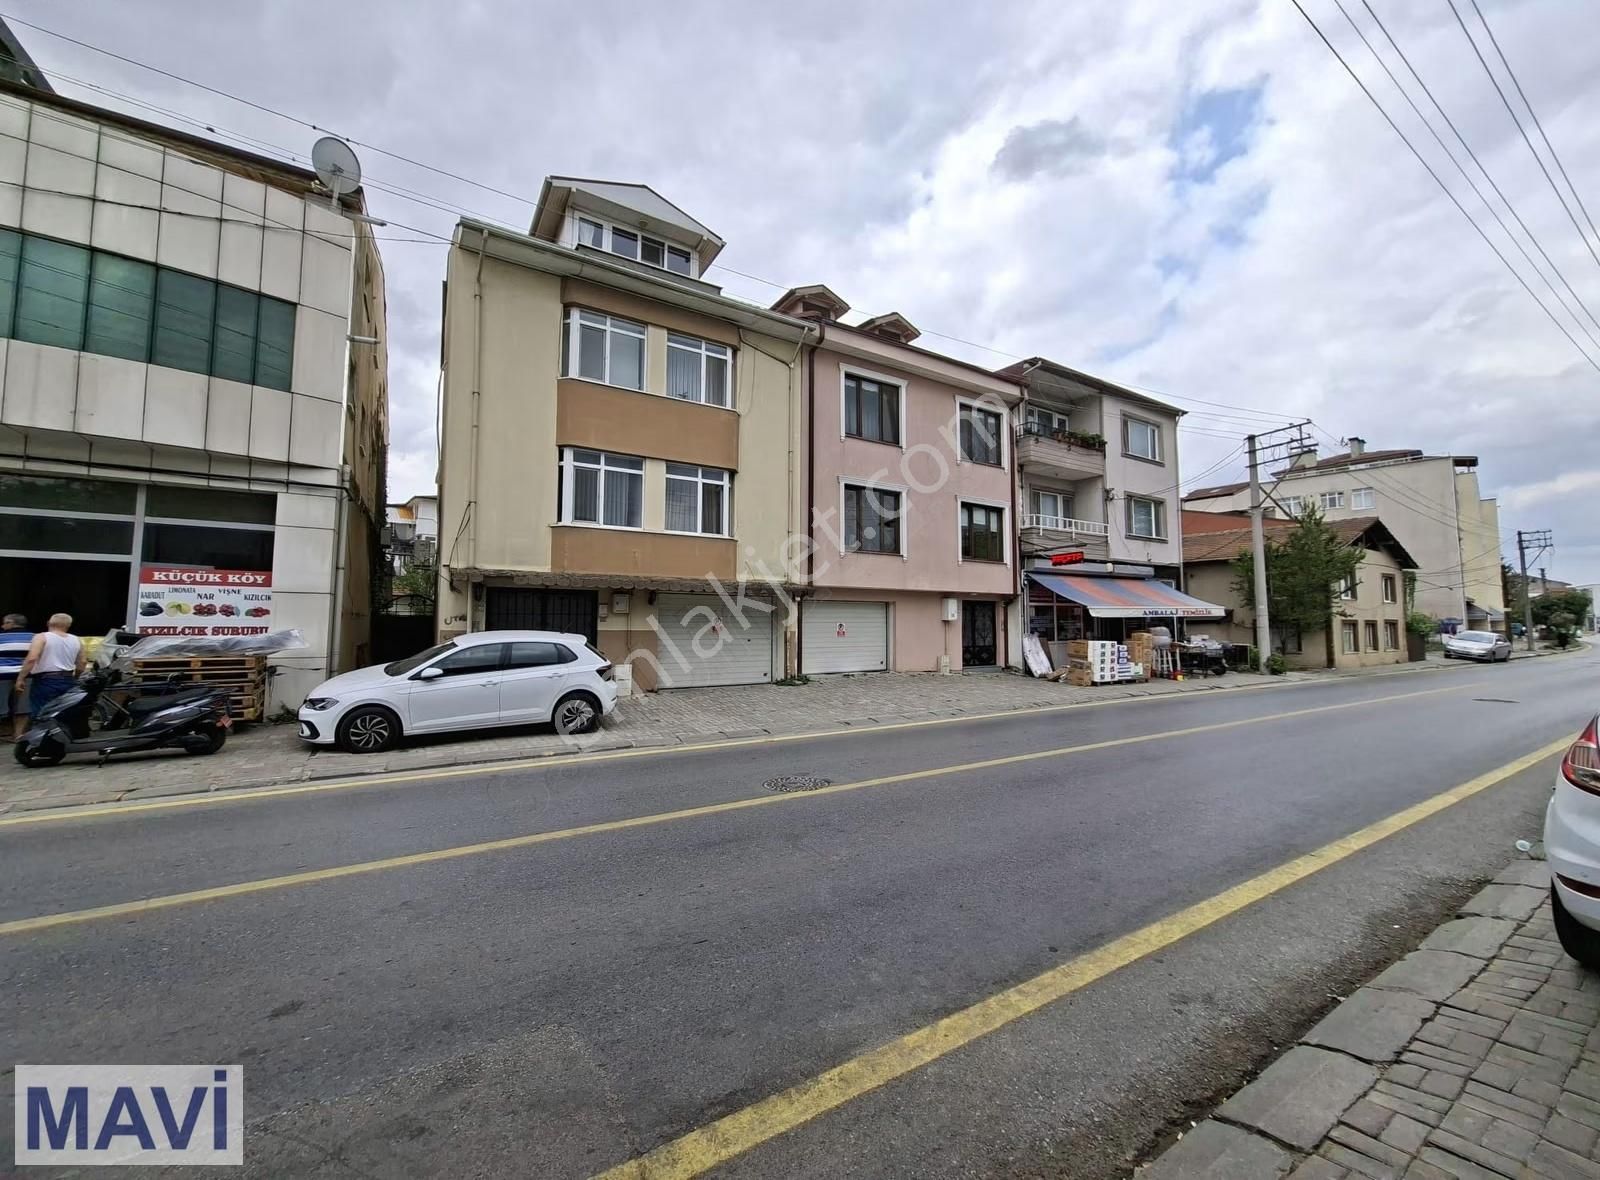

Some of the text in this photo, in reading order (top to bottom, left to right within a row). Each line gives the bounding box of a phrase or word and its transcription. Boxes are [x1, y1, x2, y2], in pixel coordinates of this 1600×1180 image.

[152, 570, 266, 584] KÜÇÜK KÖY
[139, 626, 208, 636] KIZILCIK
